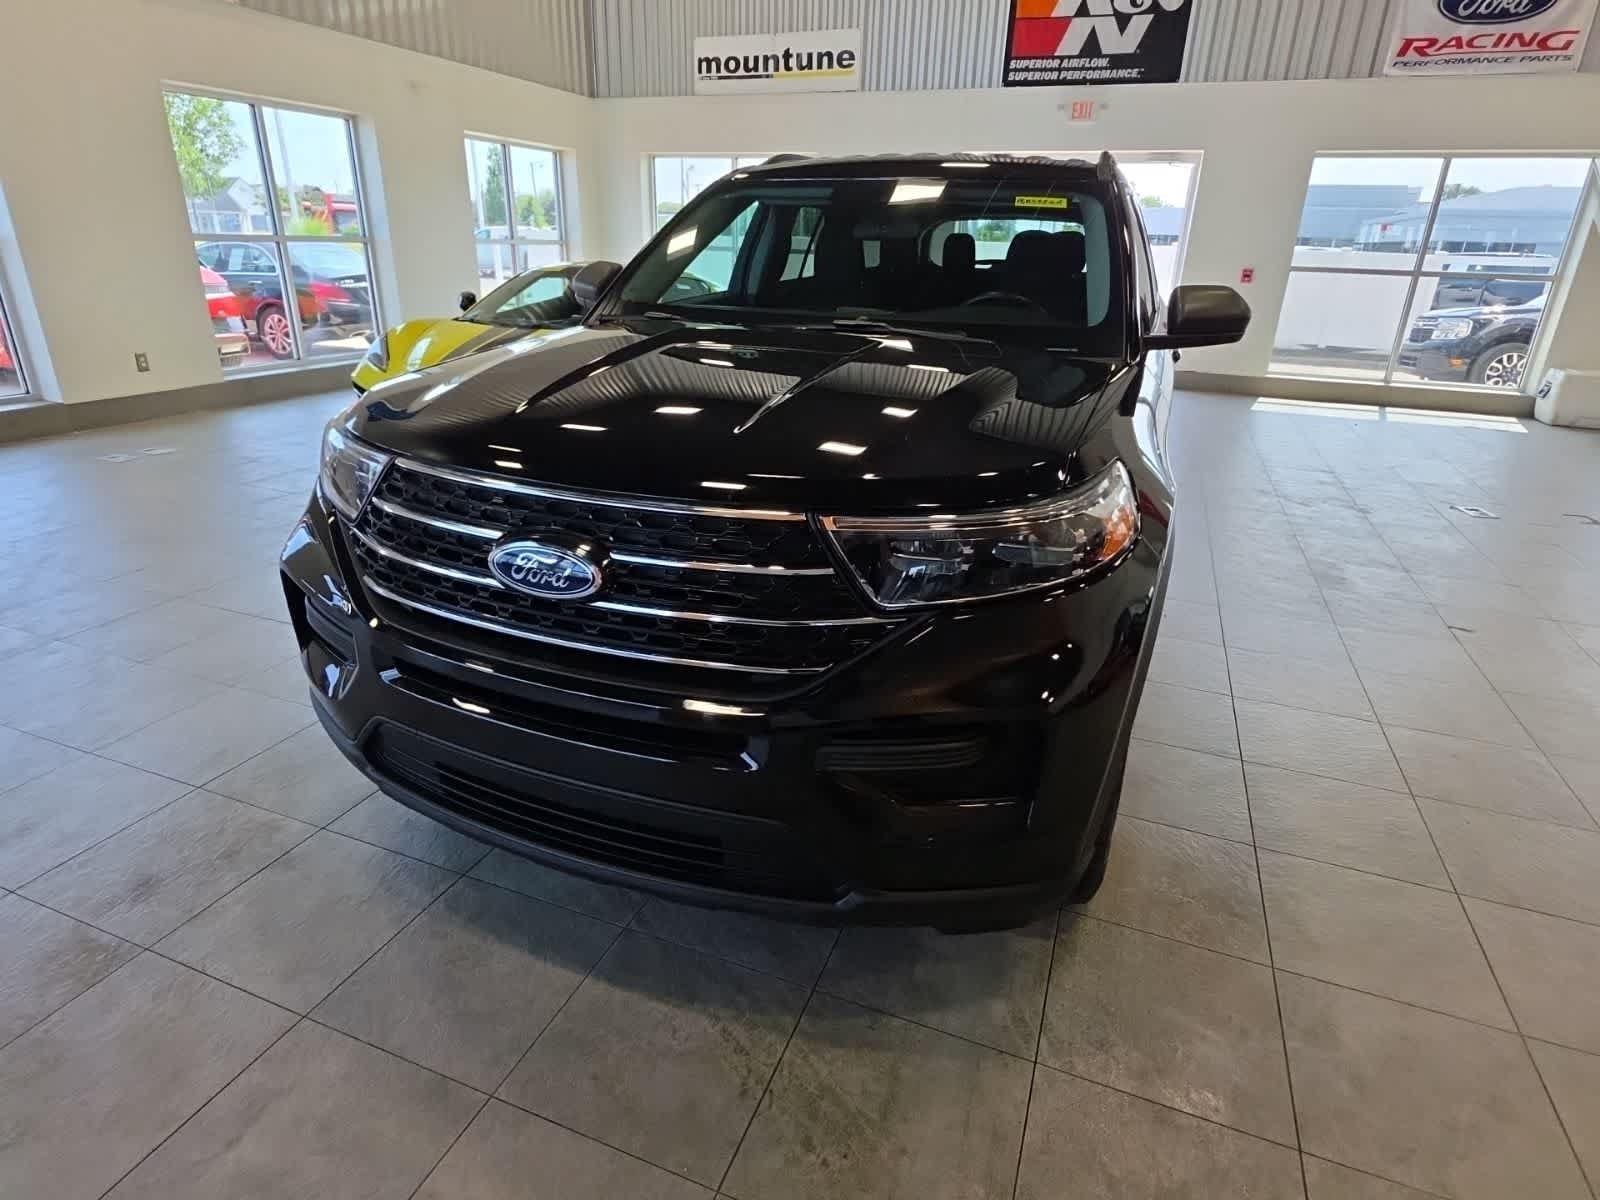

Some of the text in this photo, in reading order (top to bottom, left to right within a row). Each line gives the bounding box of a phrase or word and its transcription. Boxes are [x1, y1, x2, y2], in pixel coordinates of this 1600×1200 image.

[1396, 30, 1581, 57] RACING
[697, 47, 856, 75] mountune
[1009, 57, 1110, 69] SUPERIOR AIRFLOW.
[1392, 54, 1574, 68] PERFORMANCE PARTS
[1008, 70, 1059, 81] SUPERIOR
[1072, 101, 1095, 120] EXIT
[511, 552, 572, 588] Ford
